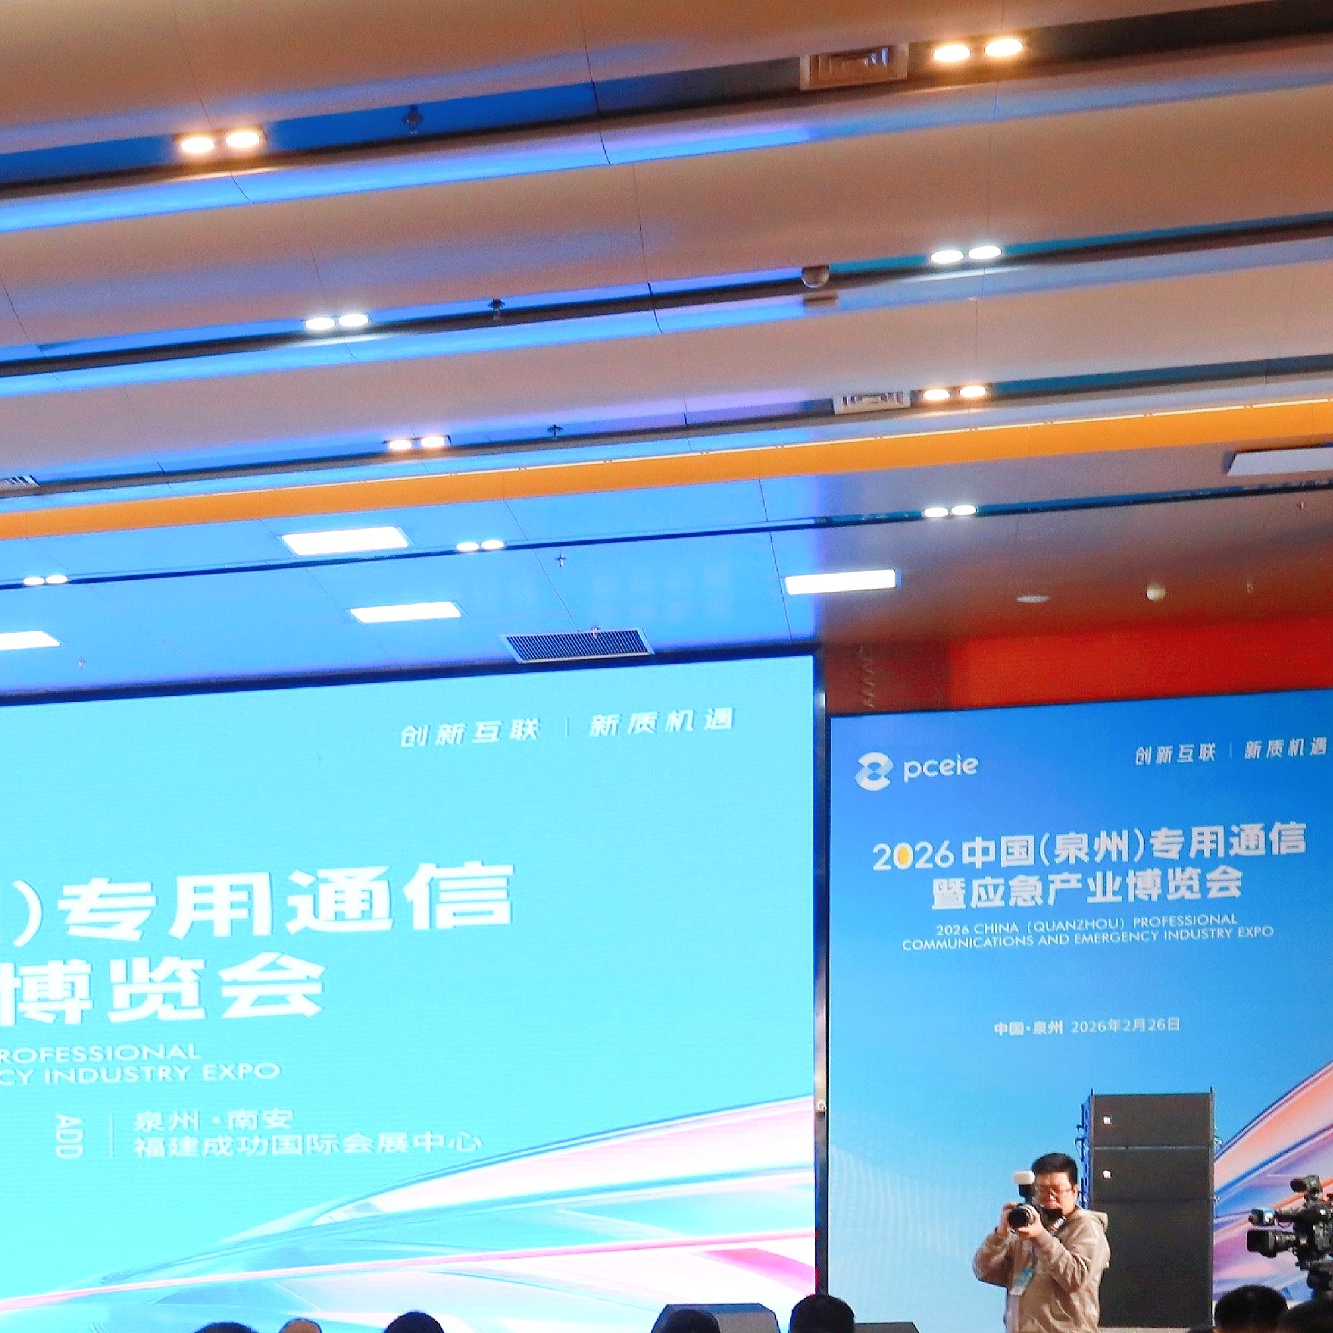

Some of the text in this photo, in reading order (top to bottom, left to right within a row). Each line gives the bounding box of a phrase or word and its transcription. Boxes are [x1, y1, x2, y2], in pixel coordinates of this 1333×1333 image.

[400, 706, 735, 748] 创新互联 新质机遇
[1134, 736, 1329, 767] 创新互联 新质机遇
[903, 753, 980, 783] pceie
[931, 865, 1244, 911] 暨应急产业博览会
[902, 926, 1275, 951] COMMUNICATIONS AND EMERGENCY INDUSTRY EXPO
[936, 923, 970, 936] 2026
[974, 922, 1020, 936] CHINA
[1133, 913, 1239, 930] PROFESSIONAL
[1070, 1017, 1181, 1034] 2026年2月26日
[43, 1065, 193, 1086] INDUSTRY
[202, 1062, 282, 1081] EXPO
[54, 1112, 85, 1161] ADD
[134, 1130, 484, 1159] 福建成功国际会展中心
